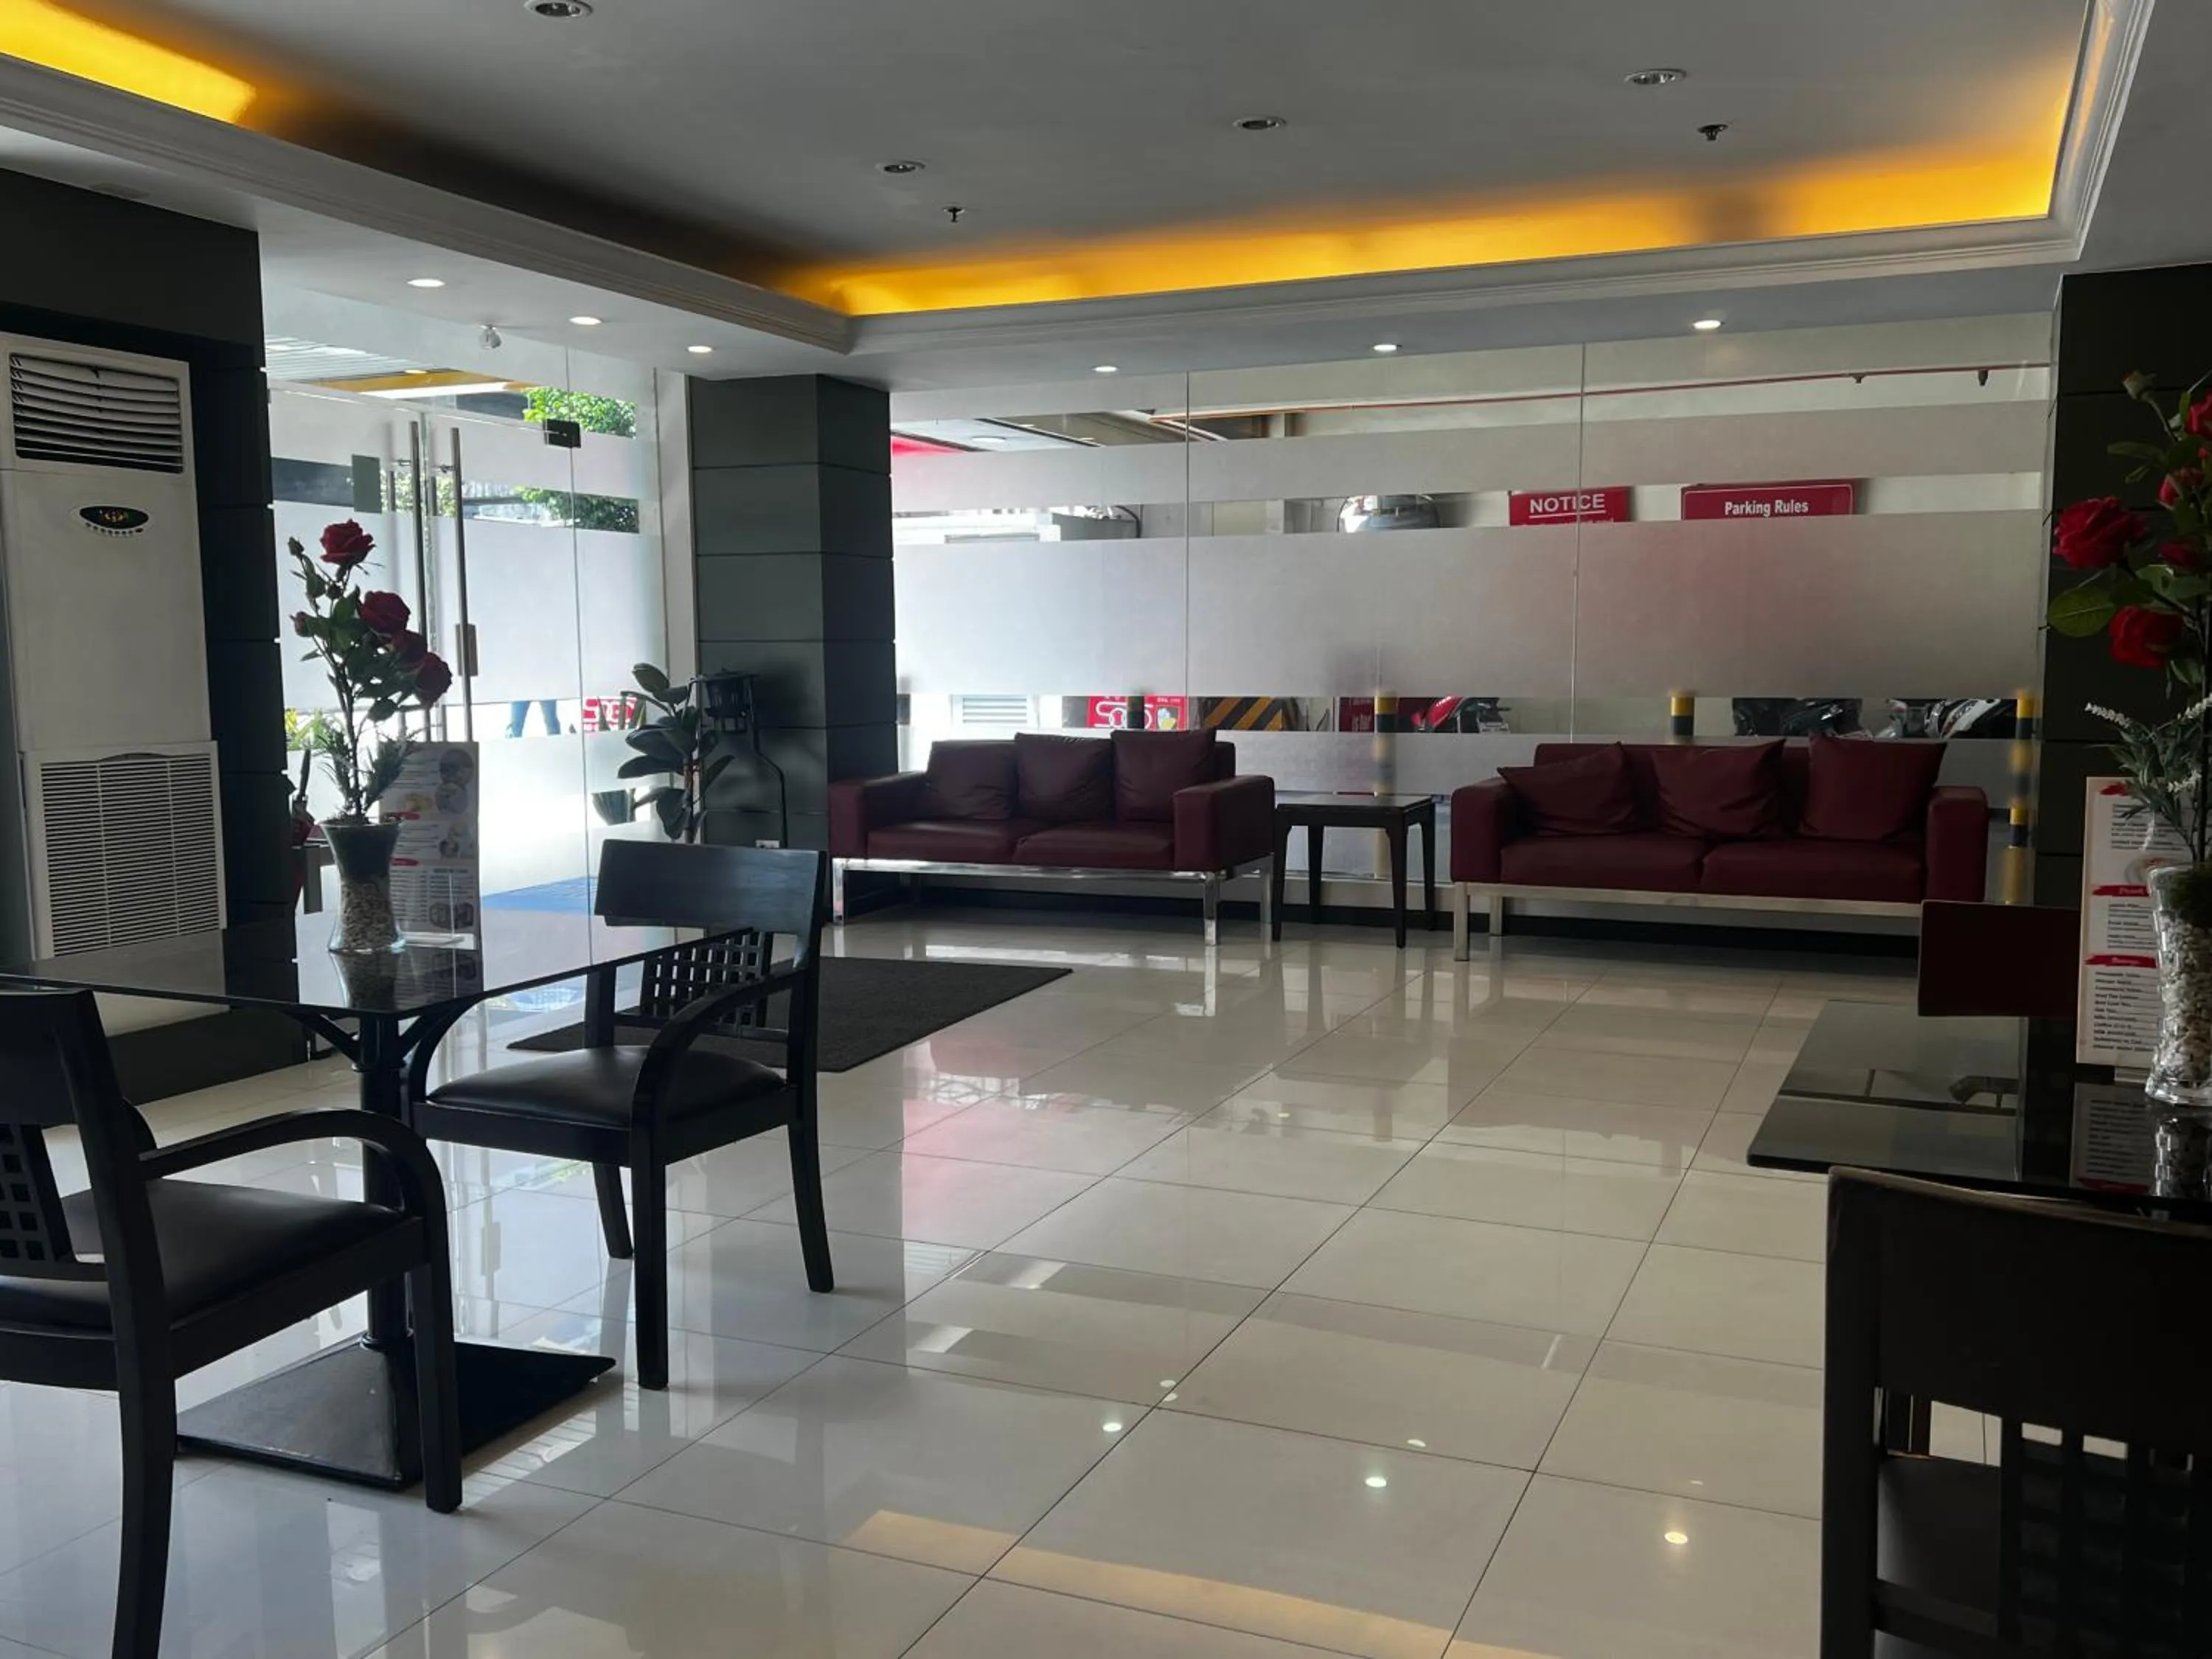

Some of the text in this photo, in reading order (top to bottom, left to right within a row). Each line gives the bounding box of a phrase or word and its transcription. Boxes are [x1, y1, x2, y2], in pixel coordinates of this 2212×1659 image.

[1529, 493, 1605, 514] NOTICE
[1724, 498, 1809, 518] Parking Rules
